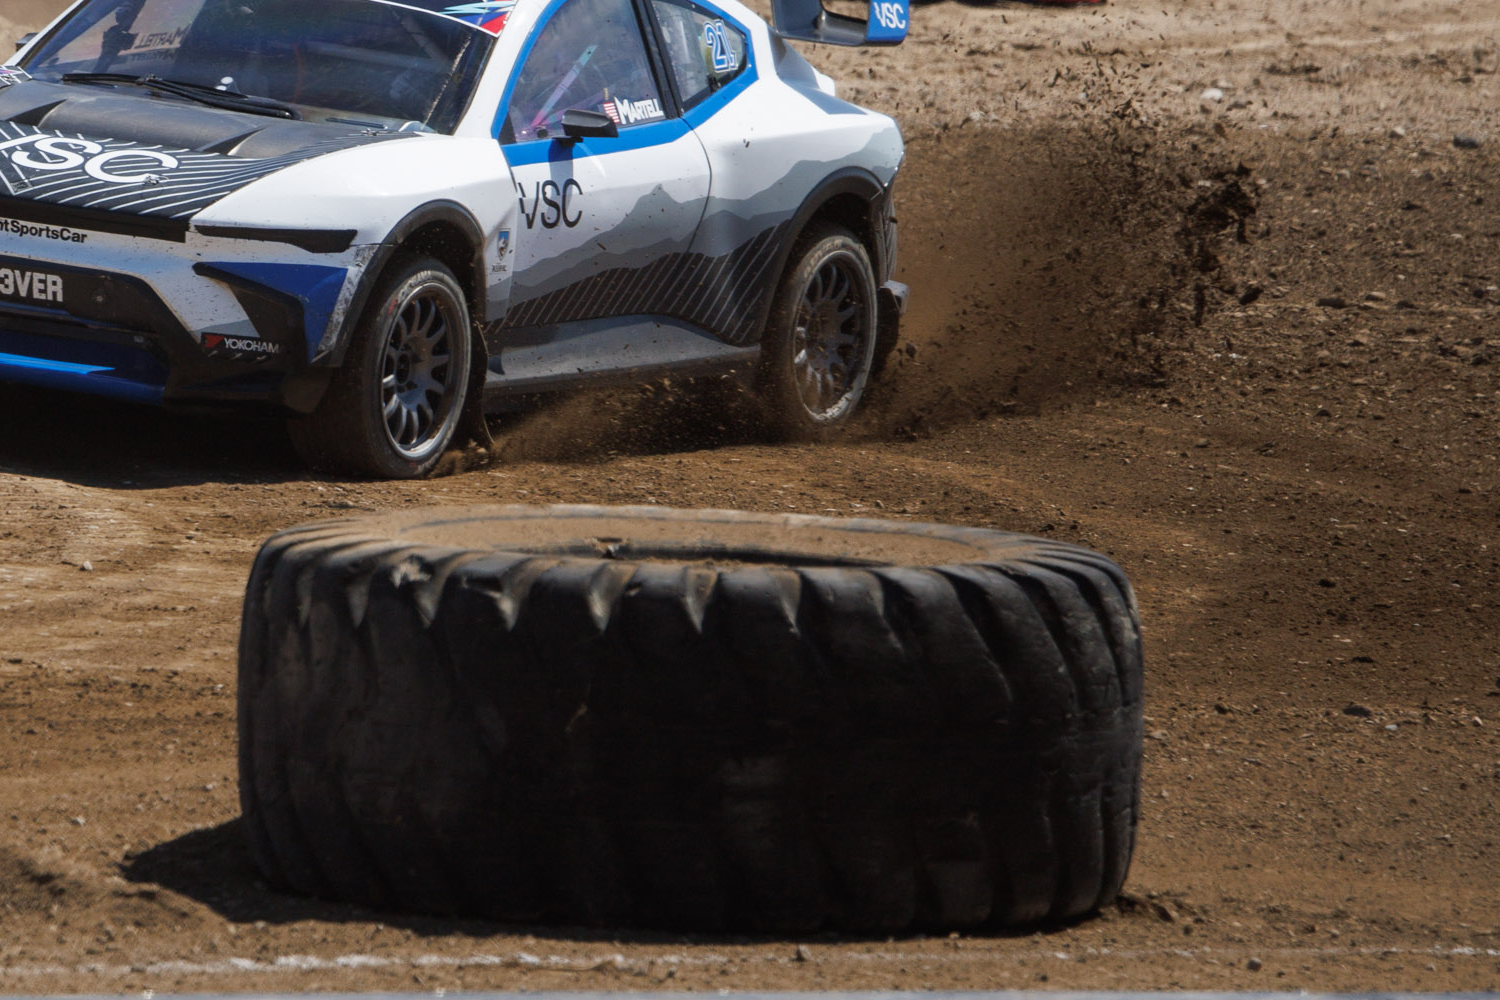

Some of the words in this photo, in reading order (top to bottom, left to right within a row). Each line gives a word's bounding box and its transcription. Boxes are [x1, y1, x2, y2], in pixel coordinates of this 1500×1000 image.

[873, 1, 906, 29] VSC
[703, 19, 739, 73] 21
[613, 97, 665, 125] MARTELL
[517, 178, 583, 230] VSC
[224, 337, 280, 354] YOKOHAM
